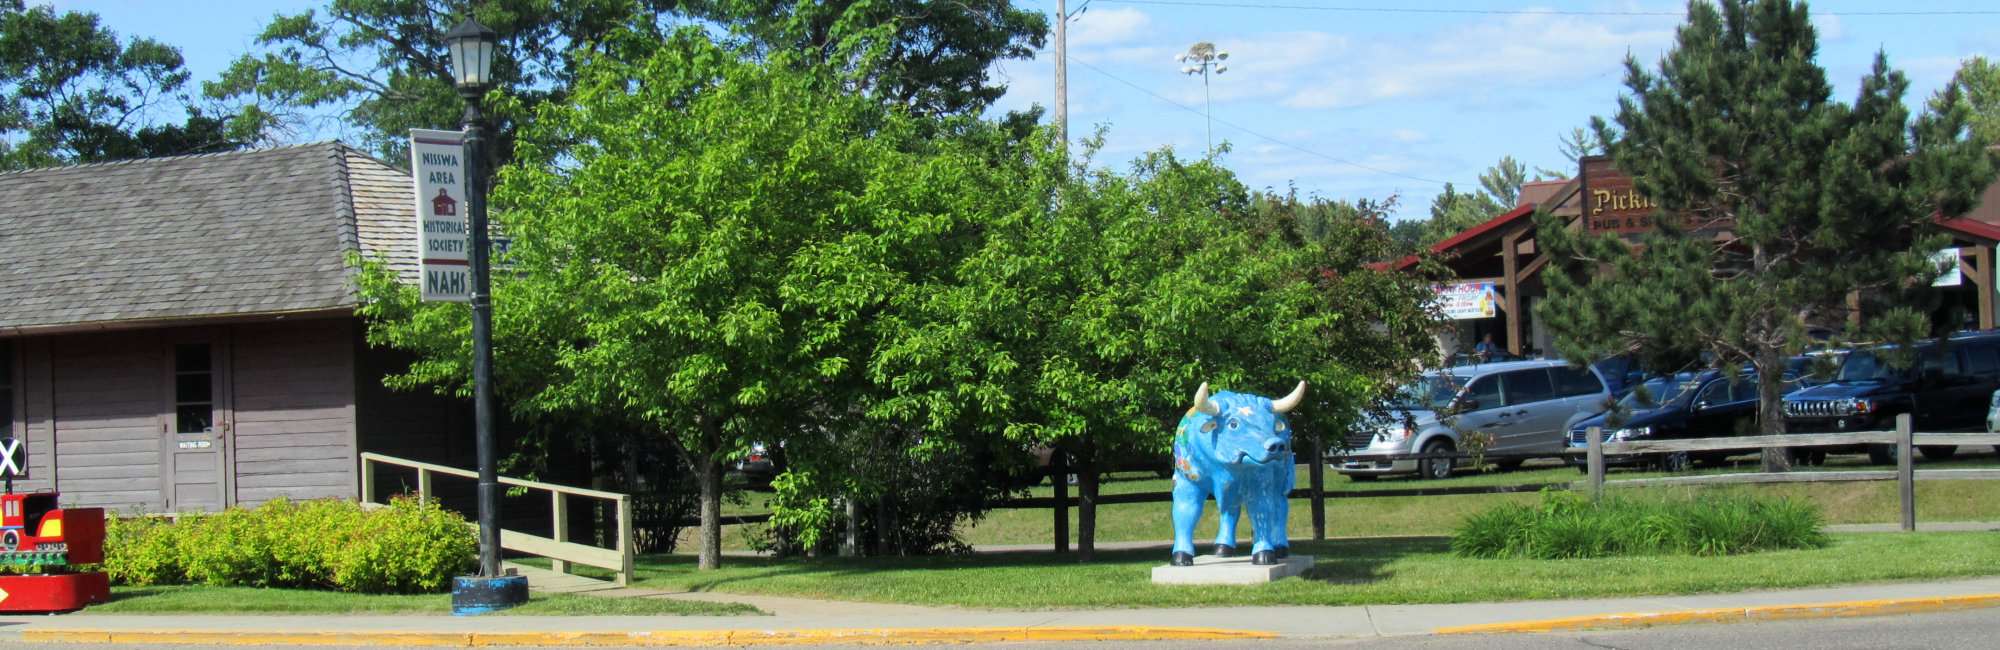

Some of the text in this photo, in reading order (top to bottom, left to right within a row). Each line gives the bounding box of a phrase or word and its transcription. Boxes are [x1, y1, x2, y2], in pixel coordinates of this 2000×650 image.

[422, 152, 458, 167] NISSWA
[429, 171, 456, 184] AREA
[429, 239, 464, 252] SOCIETY
[428, 270, 466, 294] NAHS
